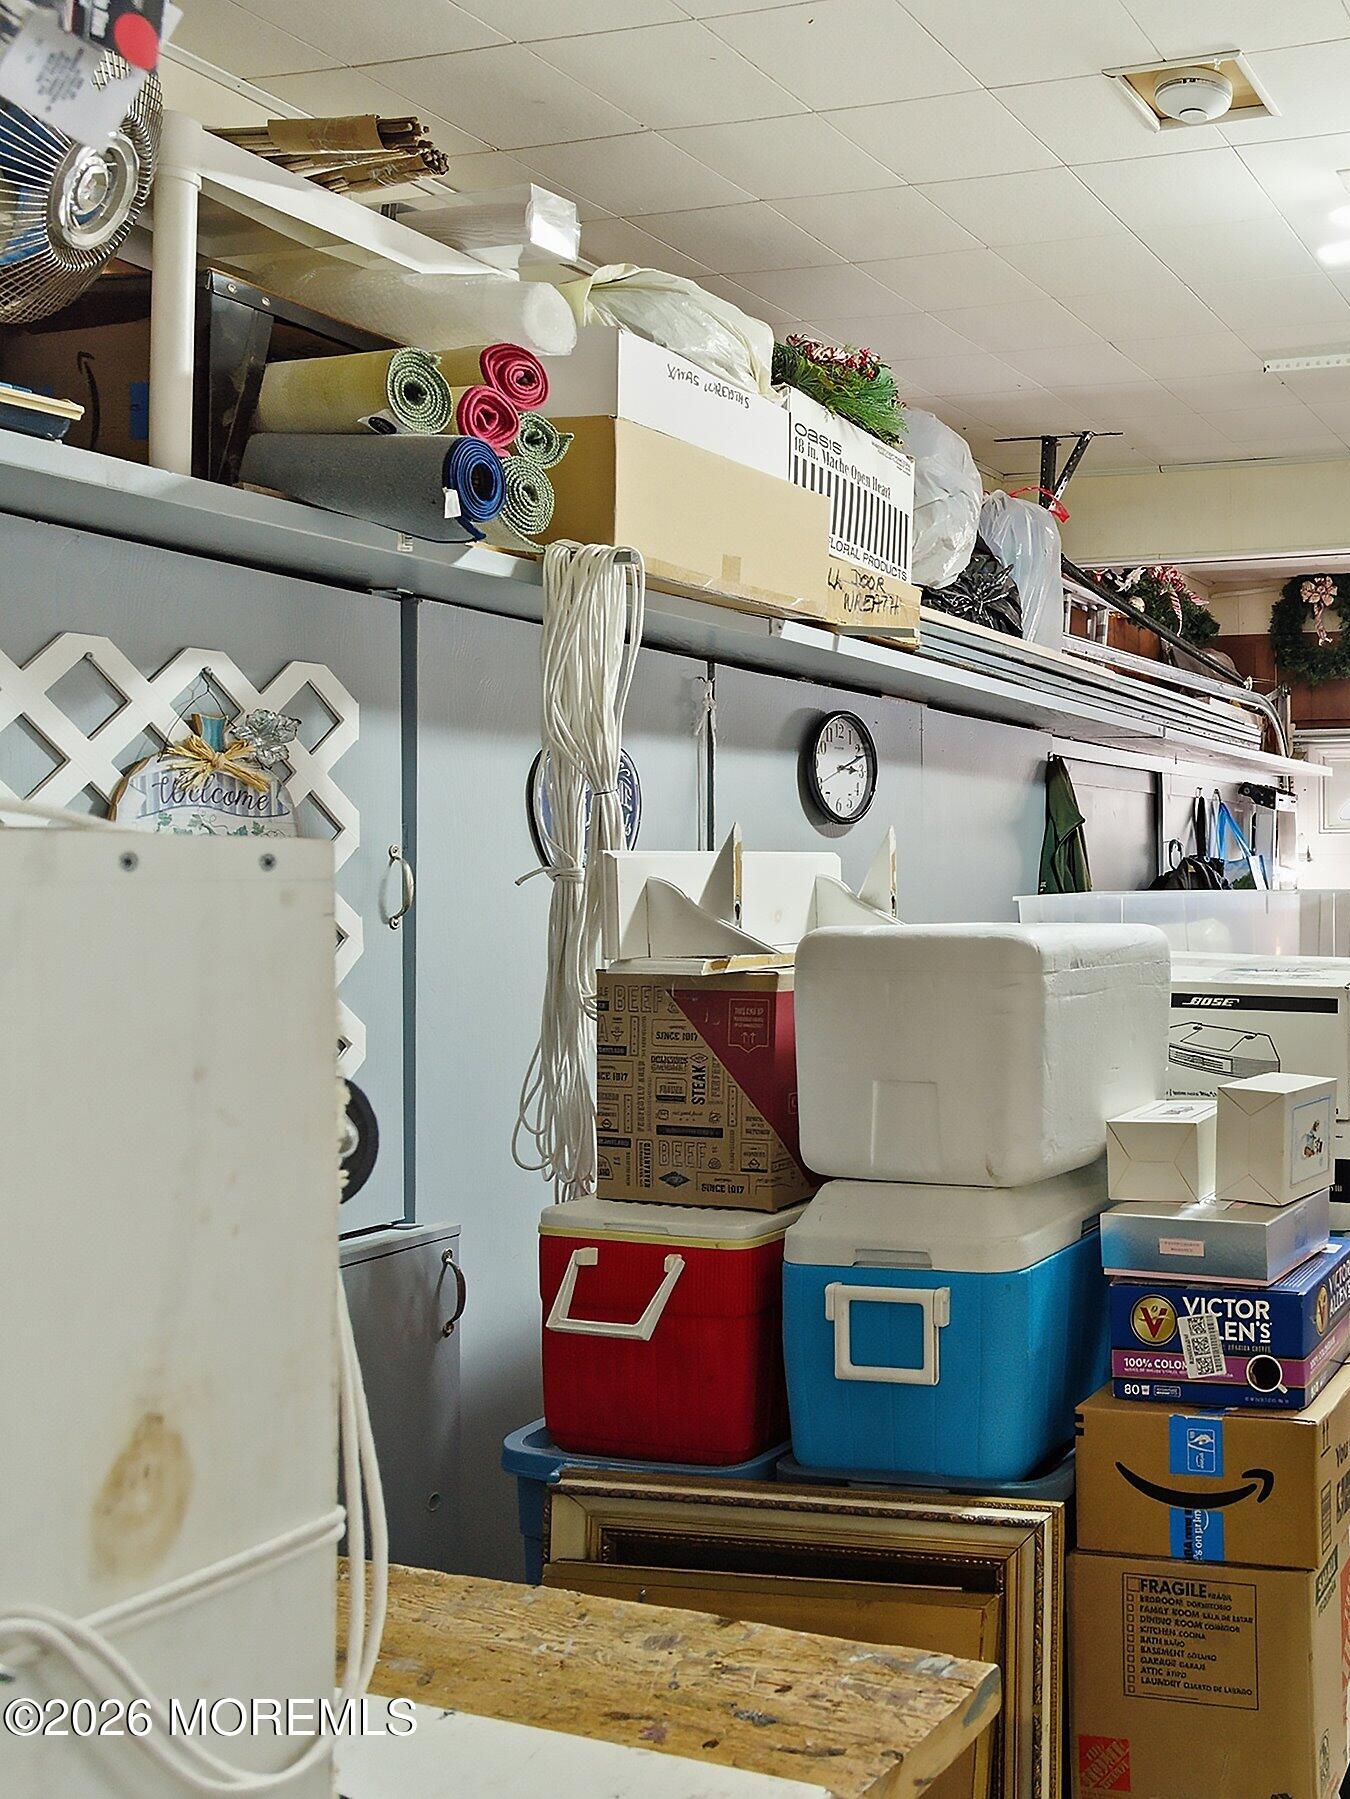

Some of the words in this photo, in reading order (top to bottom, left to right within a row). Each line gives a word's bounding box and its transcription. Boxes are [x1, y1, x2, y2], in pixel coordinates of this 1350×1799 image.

[794, 436, 805, 454] 18
[807, 442, 819, 461] in.
[821, 449, 850, 475] Mache
[851, 465, 871, 488] Open
[872, 476, 891, 499] Heart
[829, 536, 860, 561] LORAL
[862, 552, 908, 582] PRODUCTS
[835, 723, 845, 739] 12
[152, 773, 269, 811] Welcome
[614, 984, 662, 1013] BEEF
[1181, 996, 1240, 1007] BOSE
[655, 1031, 680, 1041] SINCE
[691, 1065, 706, 1105] STEAK
[659, 1140, 708, 1169] BEEF
[1182, 1296, 1270, 1320] VICTOR
[1123, 1357, 1153, 1368] 100%
[1124, 1383, 1140, 1395] 80
[1335, 1440, 1349, 1468] You
[1192, 1510, 1204, 1534] prim
[1194, 1535, 1203, 1549] on
[1140, 1578, 1207, 1599] FRAGILE
[1140, 1594, 1183, 1606] BEDROOM
[1140, 1604, 1169, 1615] FAMILY
[1172, 1608, 1200, 1618] ROOM
[1140, 1615, 1172, 1625] DINING
[1175, 1619, 1202, 1629] ROOM
[1140, 1625, 1177, 1636] KITCHEN
[1140, 1645, 1185, 1658] BASEMENT
[1140, 1656, 1176, 1667] GARAGE
[1140, 1666, 1163, 1675] ATTIC
[1140, 1677, 1182, 1688] LAUNDRY
